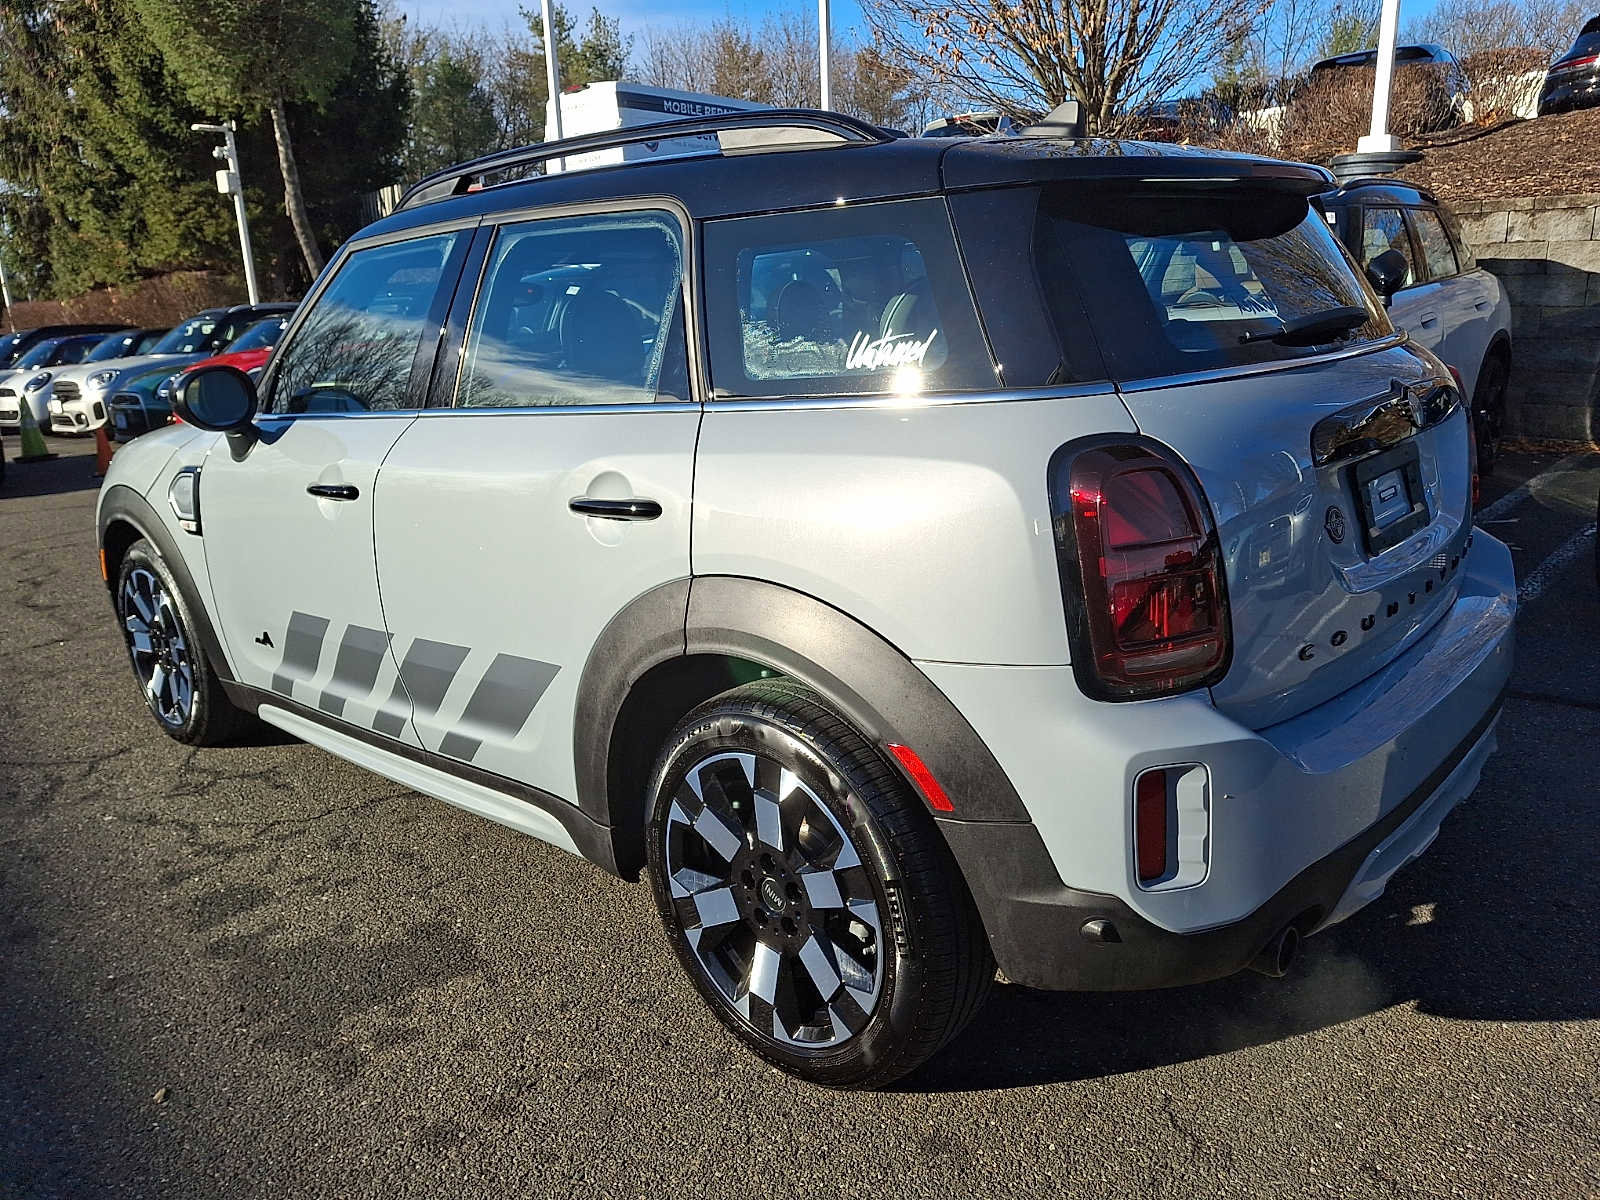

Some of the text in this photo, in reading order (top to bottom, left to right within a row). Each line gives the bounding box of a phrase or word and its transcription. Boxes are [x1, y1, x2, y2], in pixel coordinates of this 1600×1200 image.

[663, 100, 702, 116] MOBILE
[846, 327, 938, 371] Untamed
[764, 883, 784, 907] MINI
